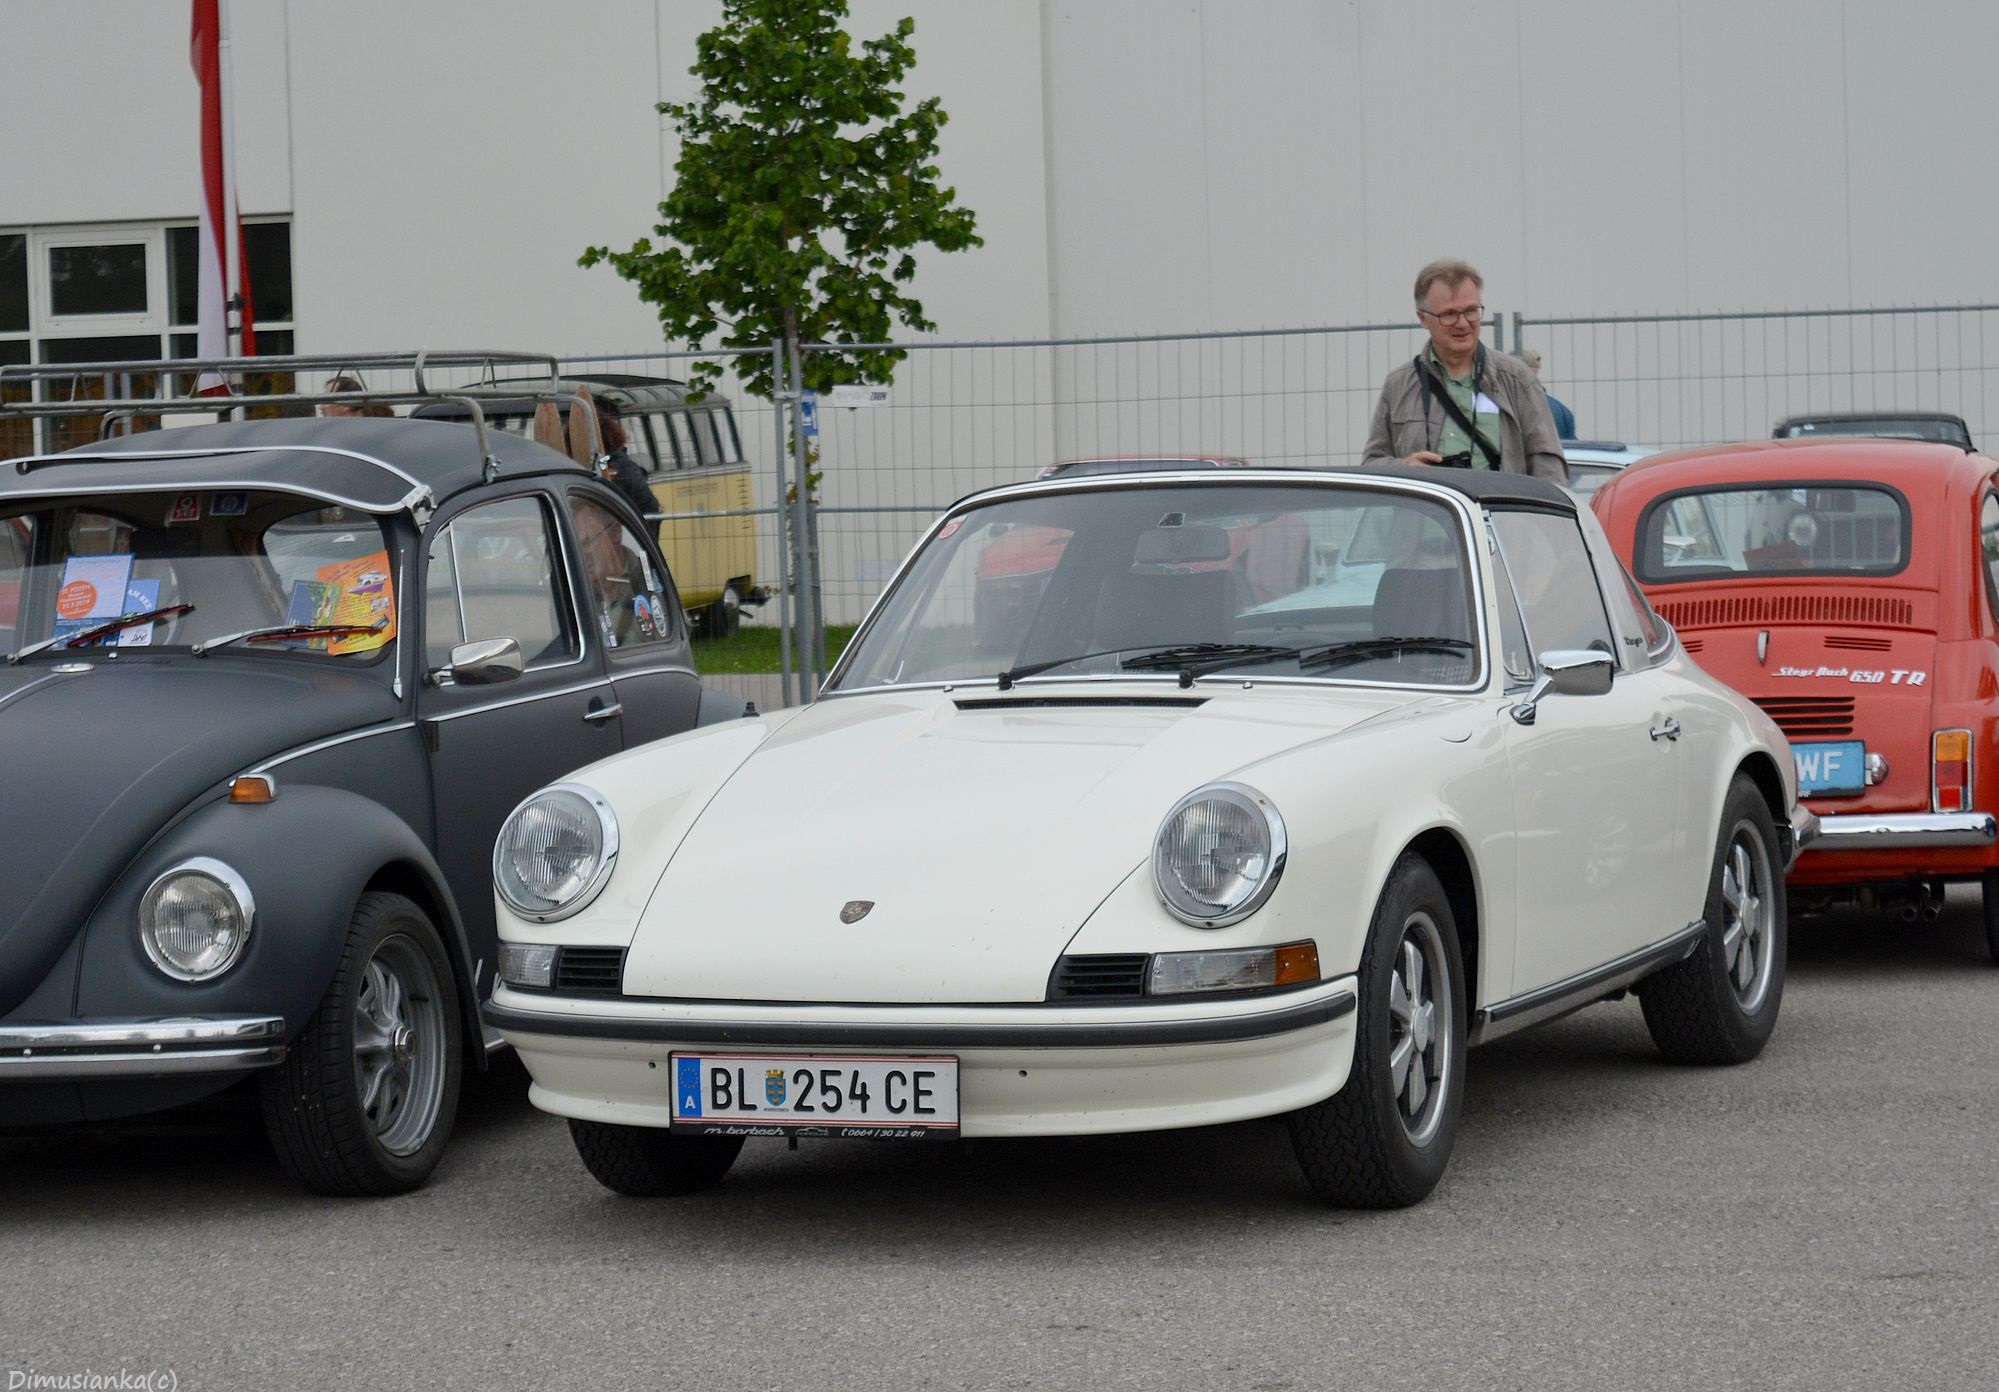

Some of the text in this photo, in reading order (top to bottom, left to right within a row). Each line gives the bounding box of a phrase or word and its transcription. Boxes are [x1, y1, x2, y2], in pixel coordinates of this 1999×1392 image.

[1850, 669, 1886, 684] 650
[1795, 751, 1844, 783] WF
[684, 1095, 696, 1109] A
[710, 1067, 936, 1115] BL 254 CE
